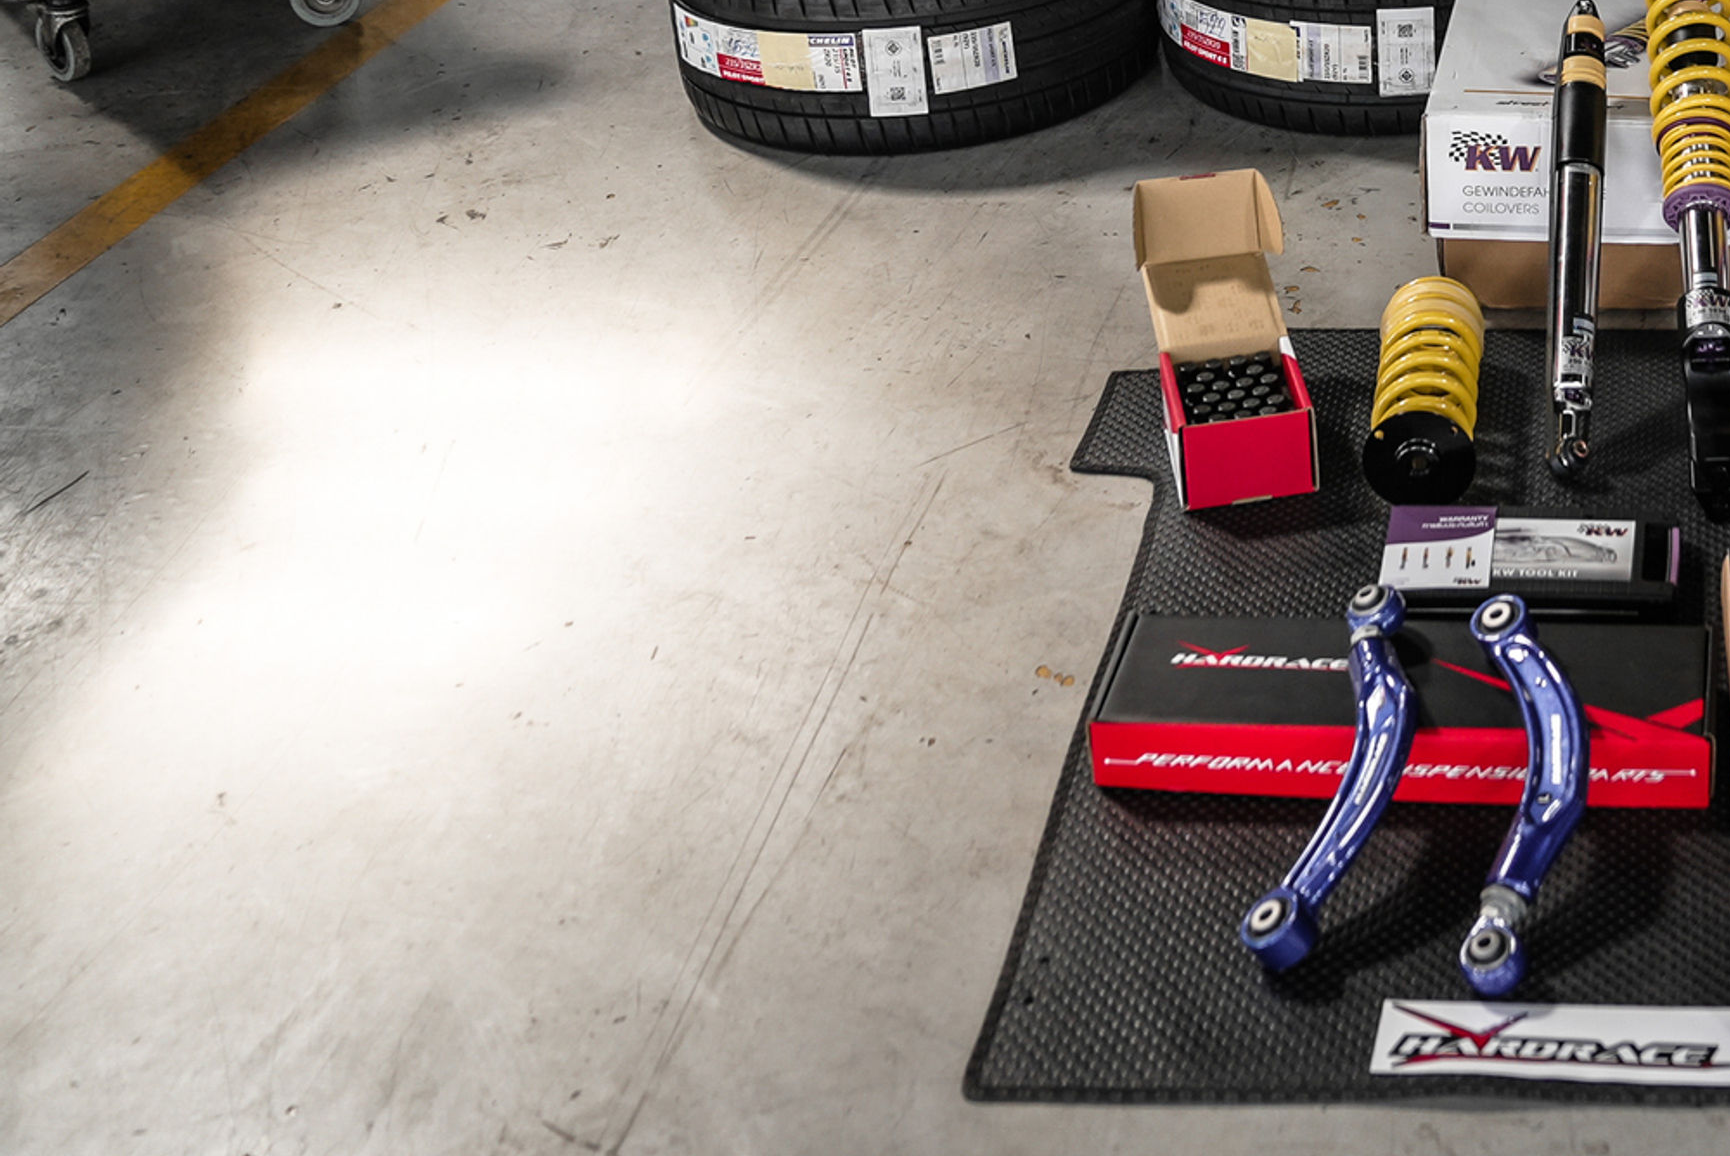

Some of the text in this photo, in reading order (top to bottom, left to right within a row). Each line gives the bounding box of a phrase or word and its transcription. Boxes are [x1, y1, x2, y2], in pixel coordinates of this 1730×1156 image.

[808, 36, 851, 46] CHELIN
[1464, 144, 1542, 172] KW
[1462, 202, 1540, 215] COILOVERS
[1492, 567, 1579, 579] KW TOOL KIT
[1170, 651, 1350, 670] HARDRACE
[1136, 751, 1350, 776] PERFORMANCE
[1402, 763, 1529, 781] SPENSI
[1389, 1033, 1719, 1067] HARDRACE
